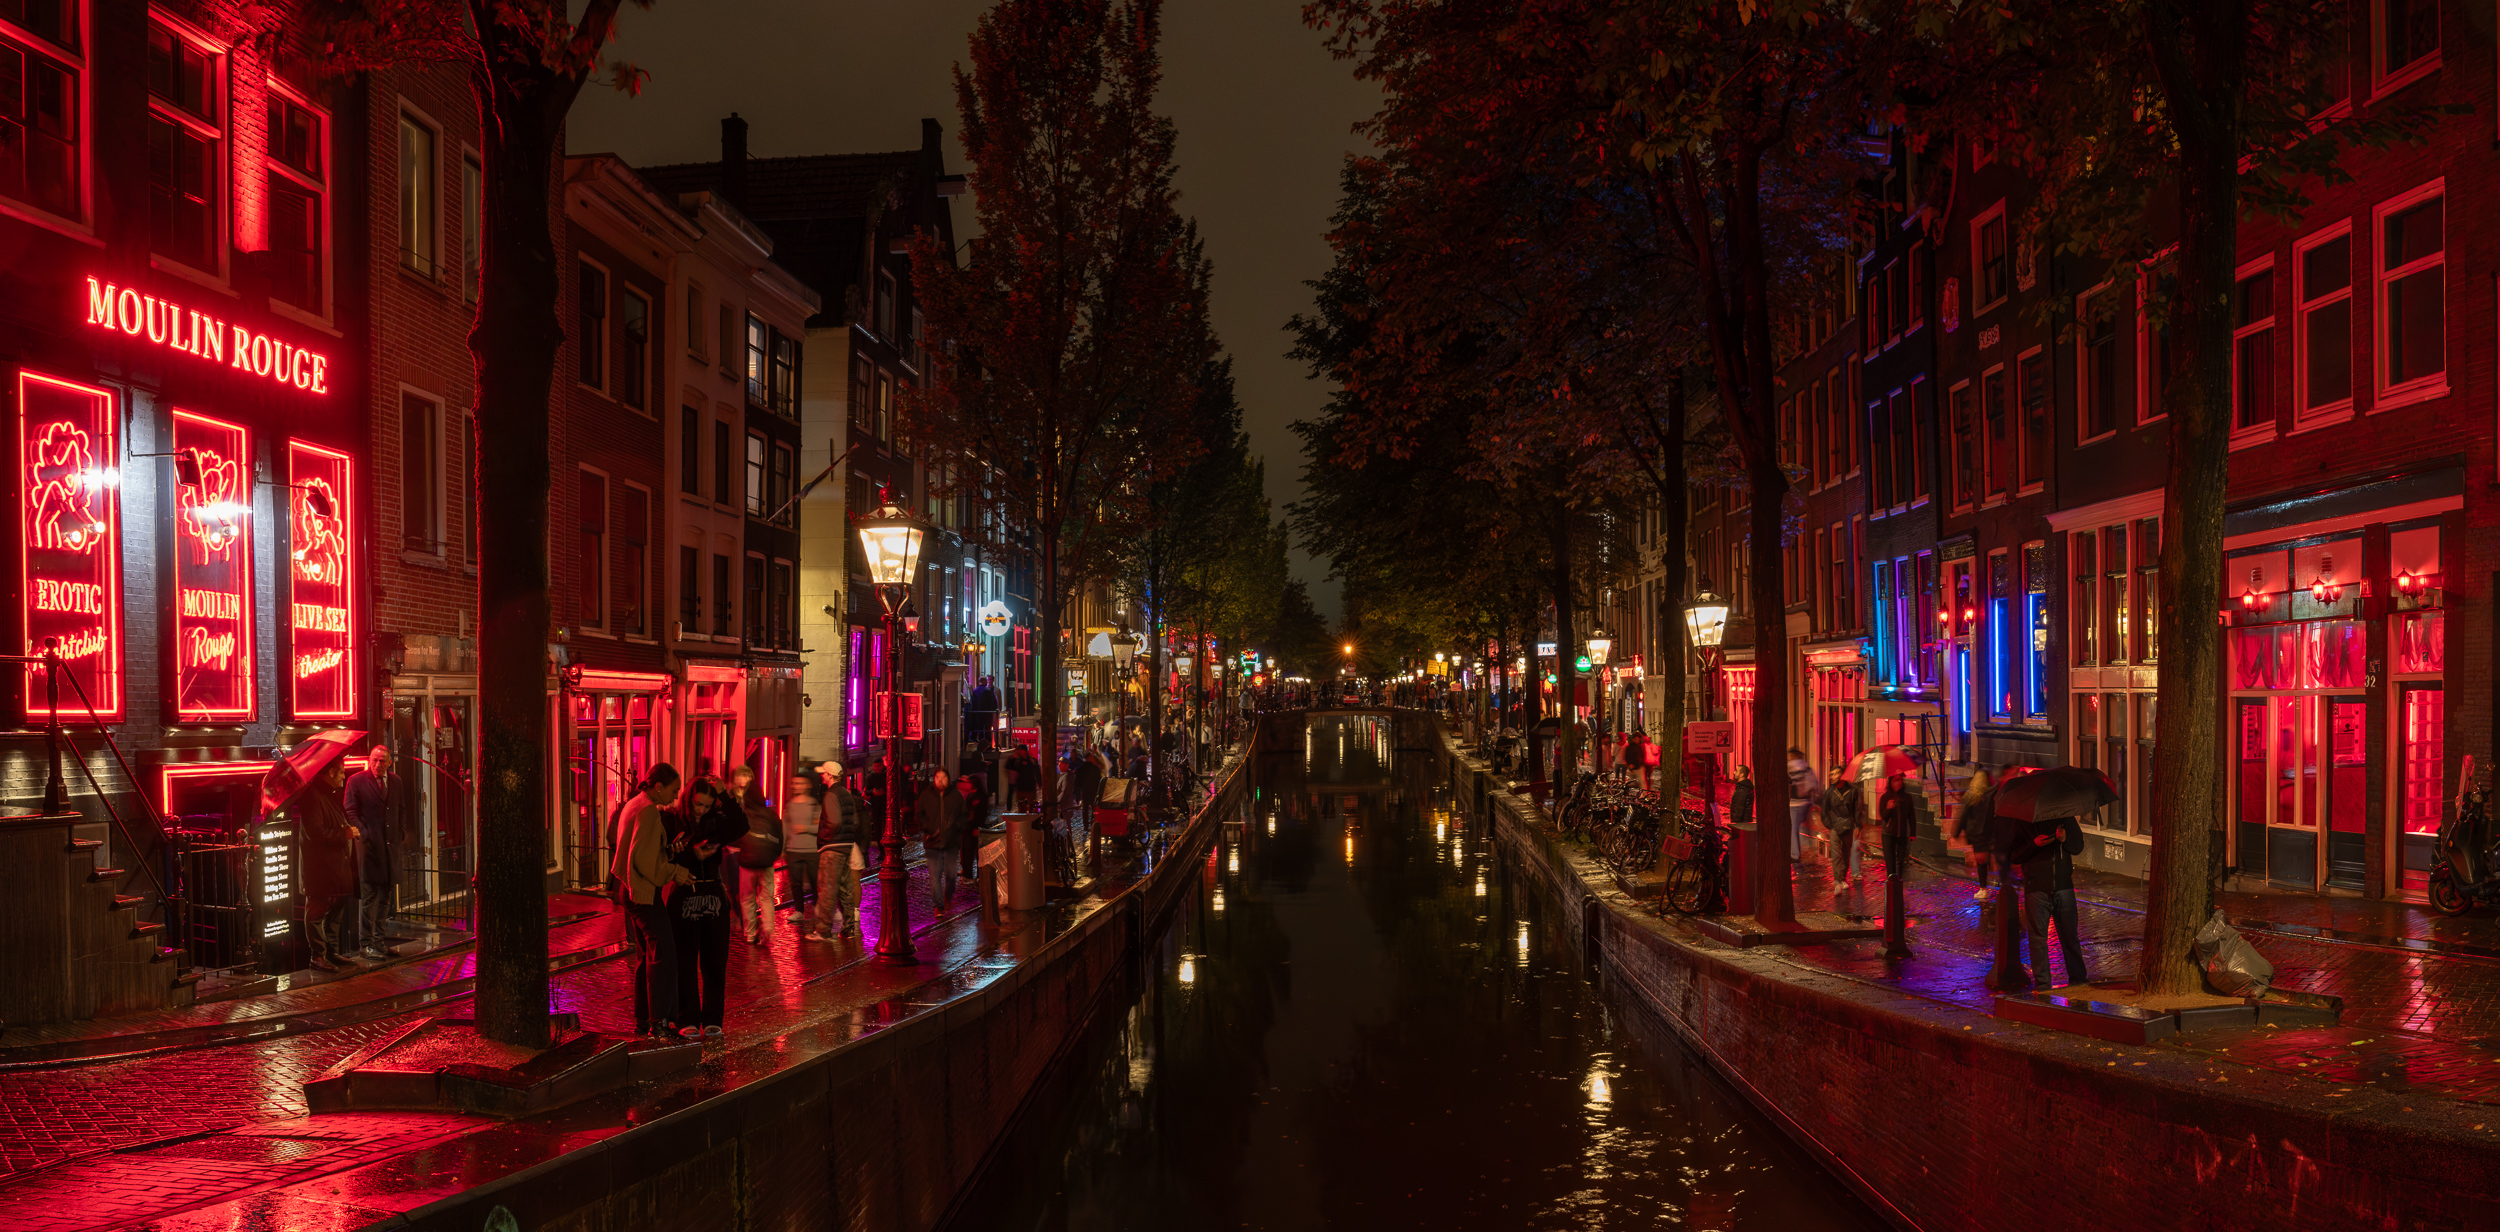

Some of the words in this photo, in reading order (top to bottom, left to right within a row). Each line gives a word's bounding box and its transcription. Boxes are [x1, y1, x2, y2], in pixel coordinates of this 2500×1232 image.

[87, 274, 225, 362] MOULIN
[232, 324, 328, 394] ROUGE
[36, 578, 102, 615] EROTIC
[183, 589, 240, 621] MOULIN
[294, 603, 323, 630] LIVE
[325, 607, 347, 632] SEX
[32, 627, 107, 672] nhtclub
[191, 626, 235, 671] Rouge
[300, 647, 344, 679] theater
[1538, 647, 1555, 655] BAR
[2365, 674, 2376, 688] 32
